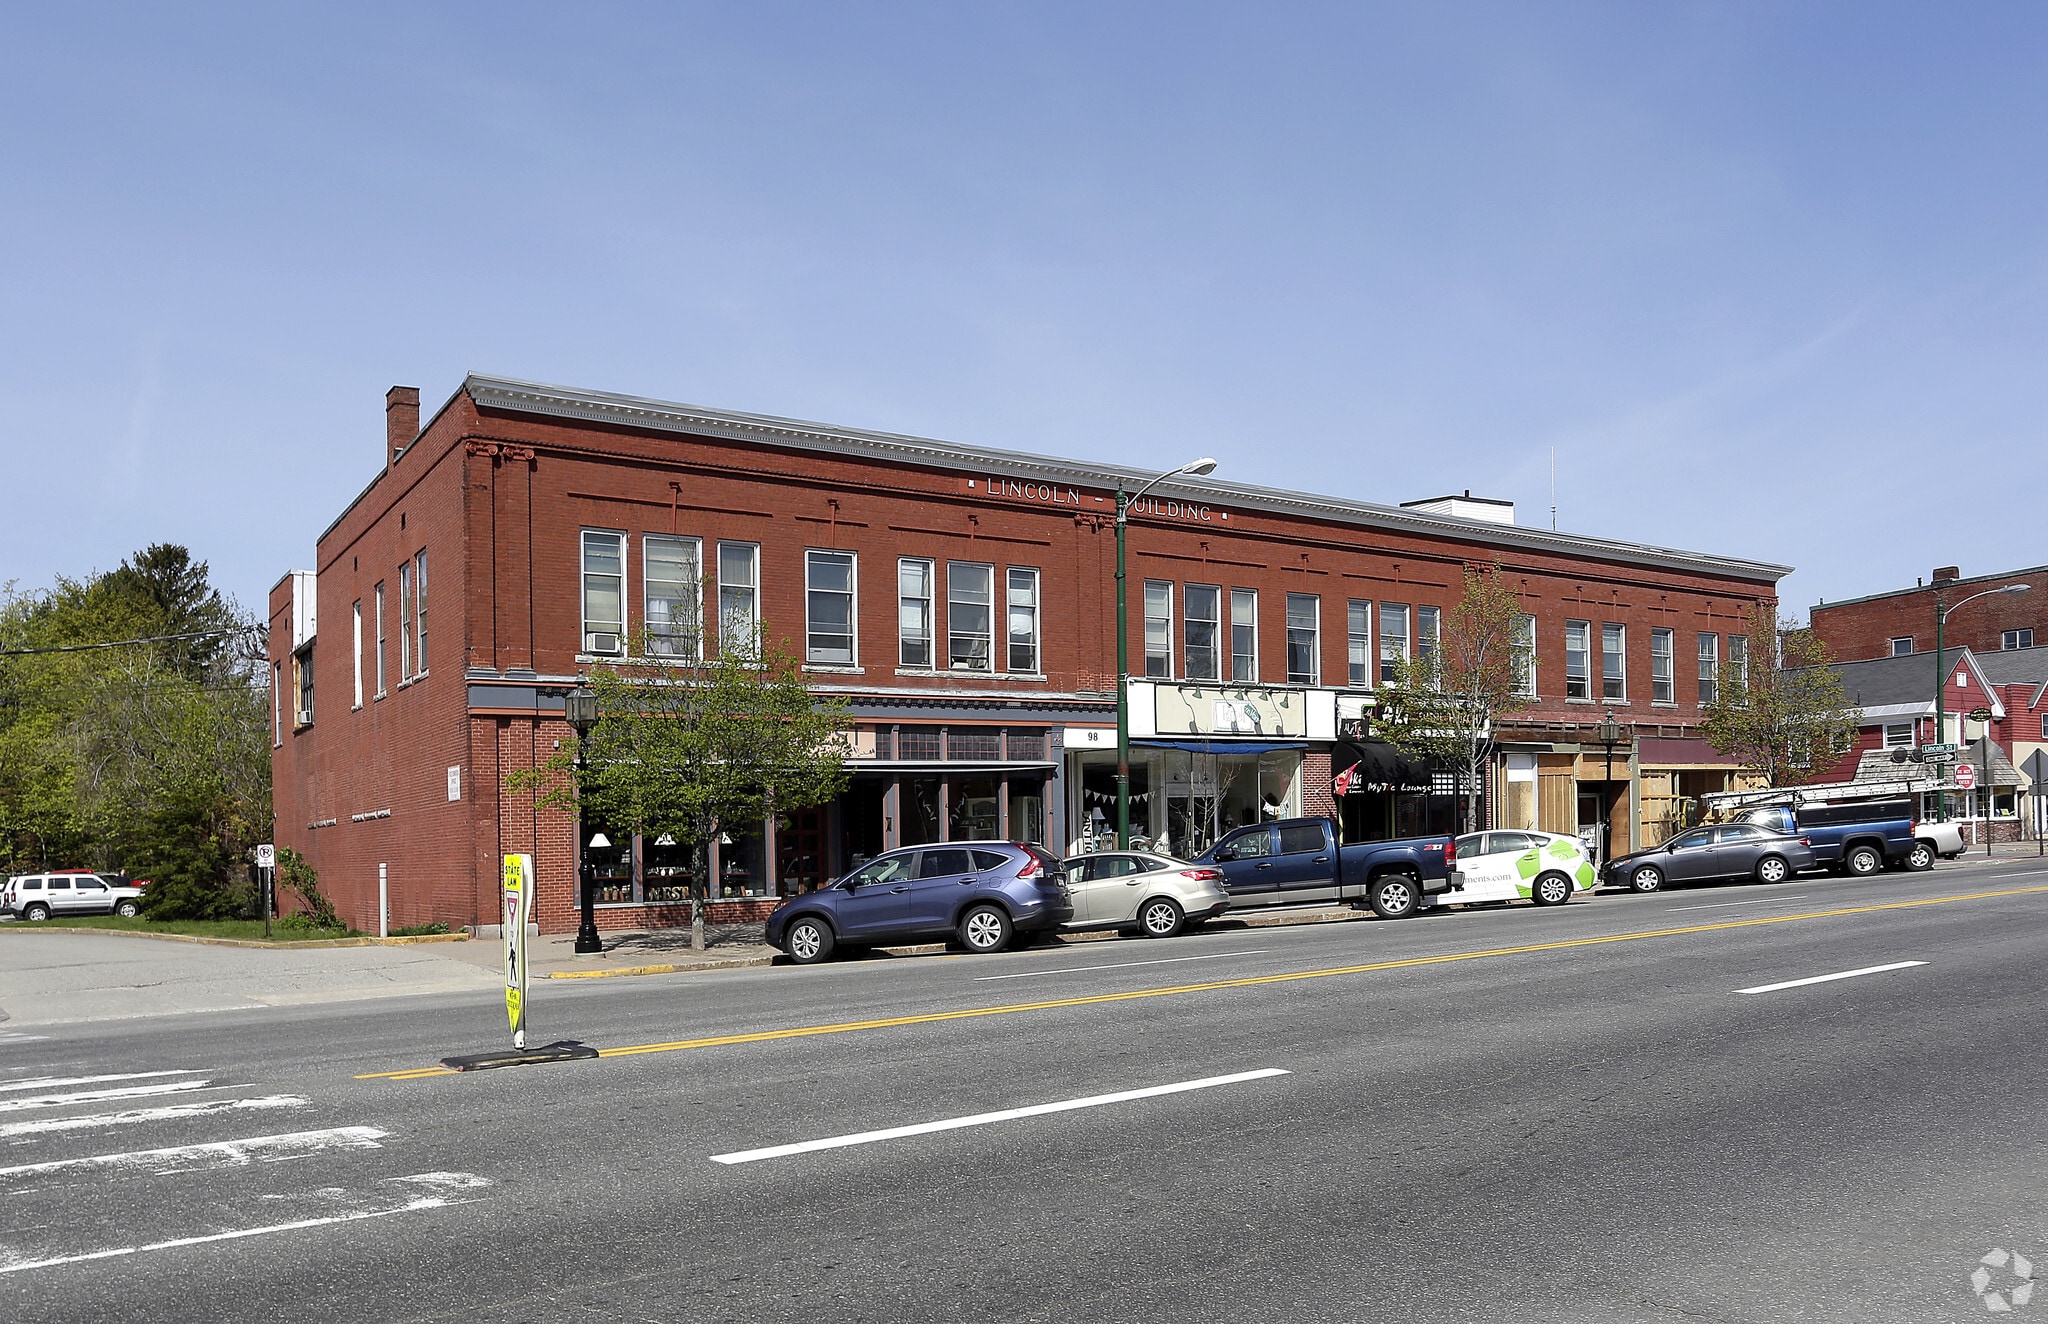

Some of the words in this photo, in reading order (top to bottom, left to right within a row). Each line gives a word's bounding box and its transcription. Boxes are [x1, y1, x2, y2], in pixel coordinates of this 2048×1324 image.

[987, 478, 1080, 505] LINCOLN
[1087, 732, 1098, 741] 98
[1400, 782, 1432, 793] Lounge
[505, 865, 520, 876] STATE
[1465, 874, 1511, 884] ments.com
